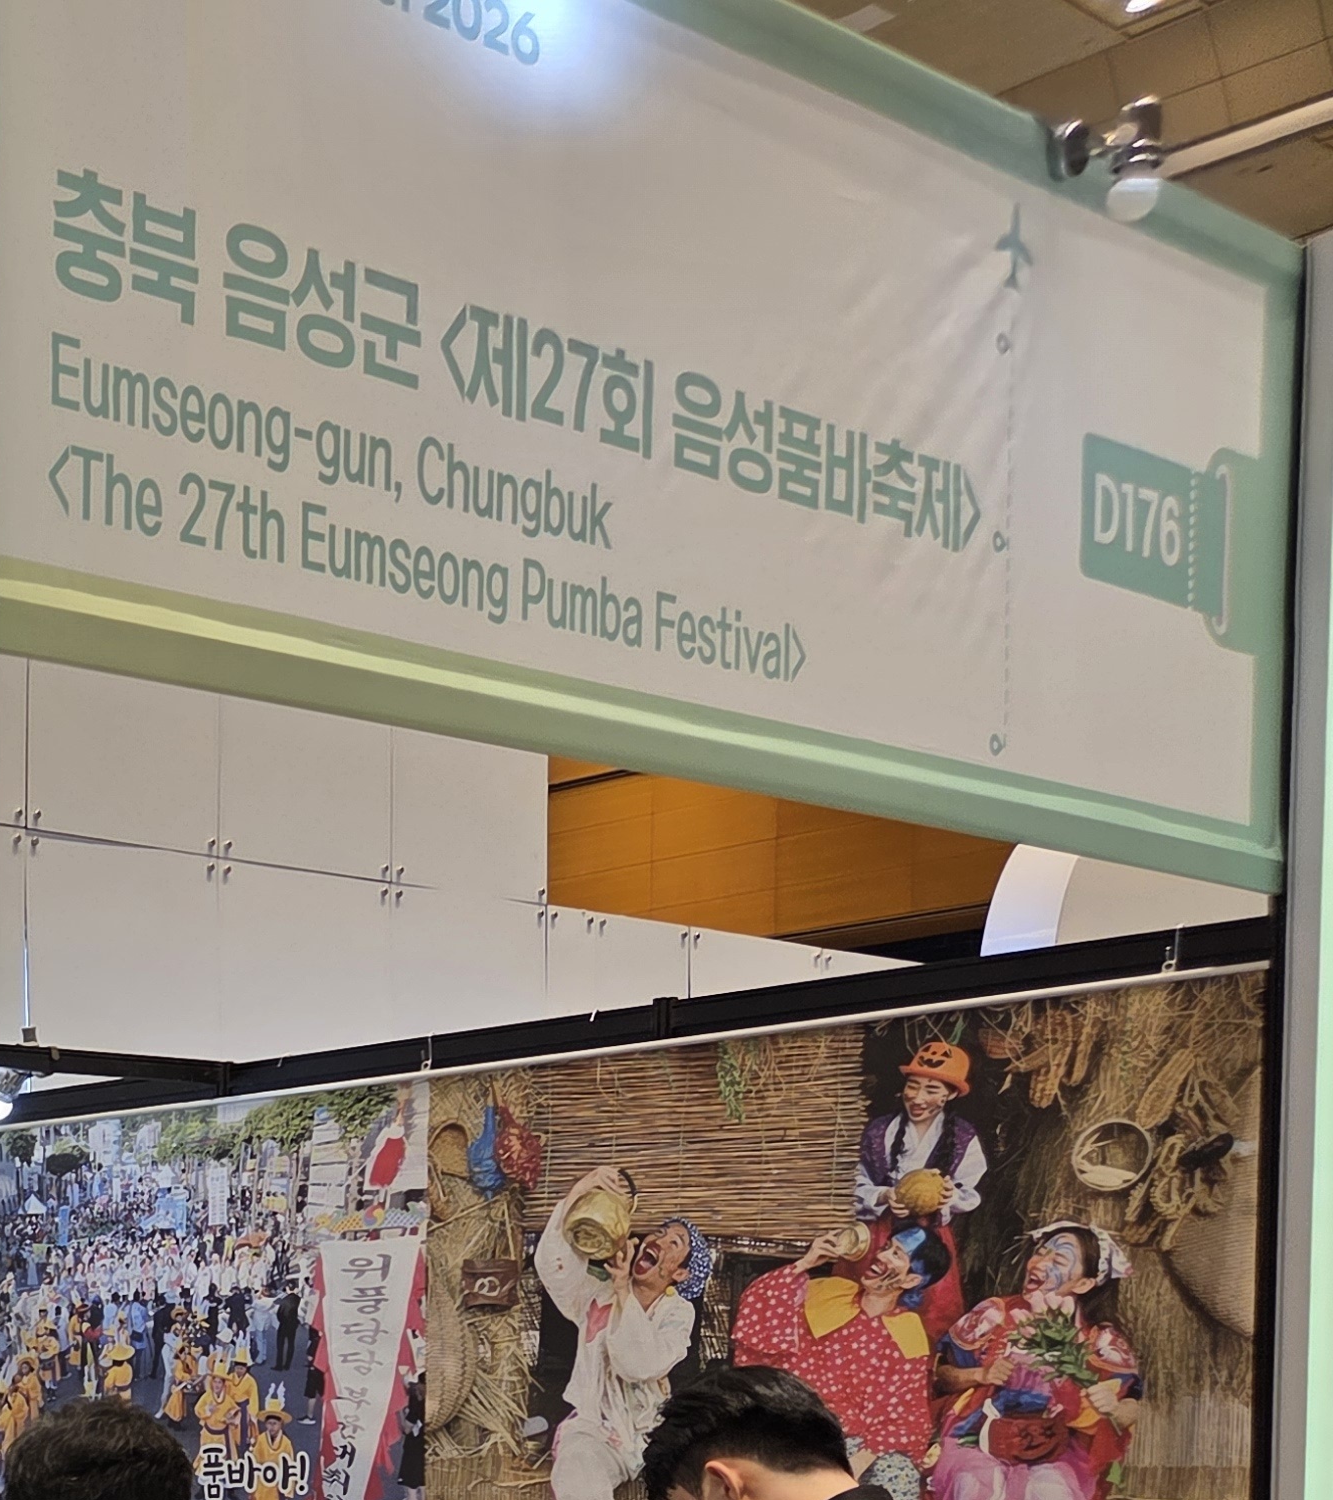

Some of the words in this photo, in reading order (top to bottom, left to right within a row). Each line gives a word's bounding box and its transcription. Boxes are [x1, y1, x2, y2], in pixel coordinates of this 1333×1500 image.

[52, 167, 200, 326] 충북
[222, 222, 422, 390] 음성군
[50, 330, 403, 504] Eumseong-gun,
[416, 435, 614, 551] Chungbuk
[1093, 472, 1181, 567] D176
[178, 472, 285, 563] 27th
[301, 500, 510, 626] Eumseong
[521, 556, 644, 649] Pumba
[200, 1446, 309, 1500] 품바야!
